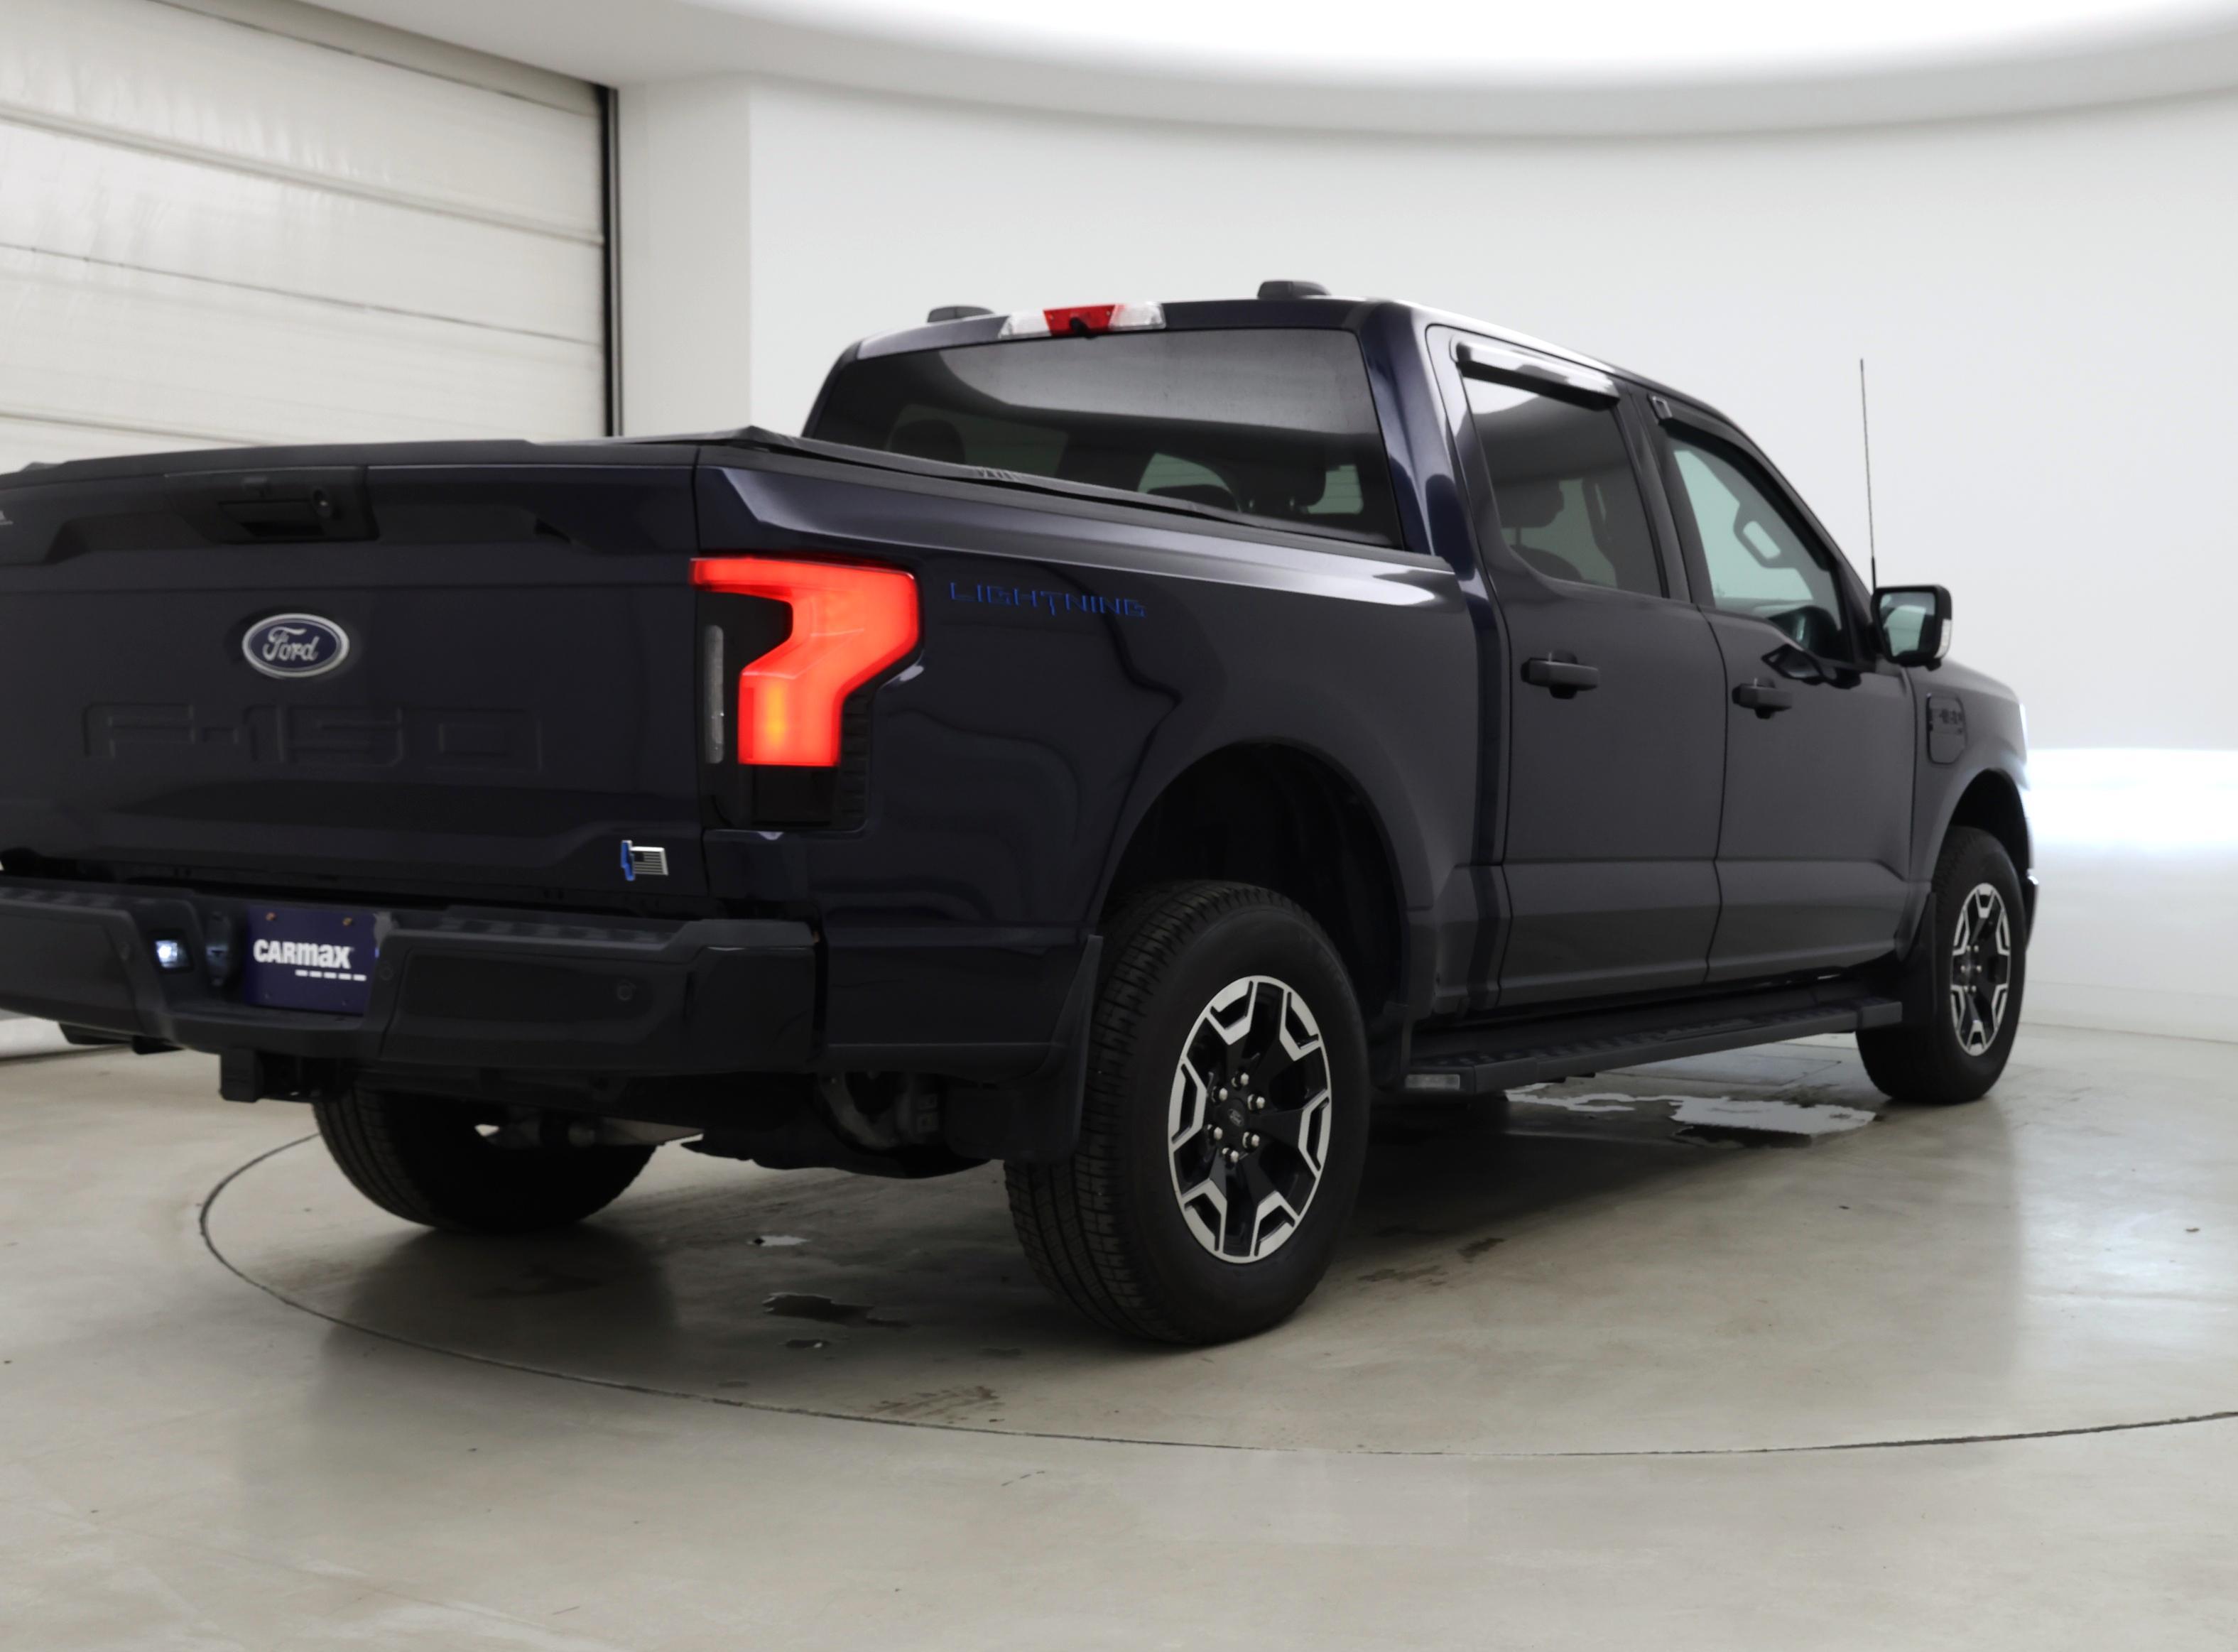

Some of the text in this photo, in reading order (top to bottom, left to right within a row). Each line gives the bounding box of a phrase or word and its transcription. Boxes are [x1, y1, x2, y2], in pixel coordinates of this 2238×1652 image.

[948, 581, 1147, 618] LIGHTNING
[262, 626, 320, 662] Ford
[82, 702, 543, 773] F-150
